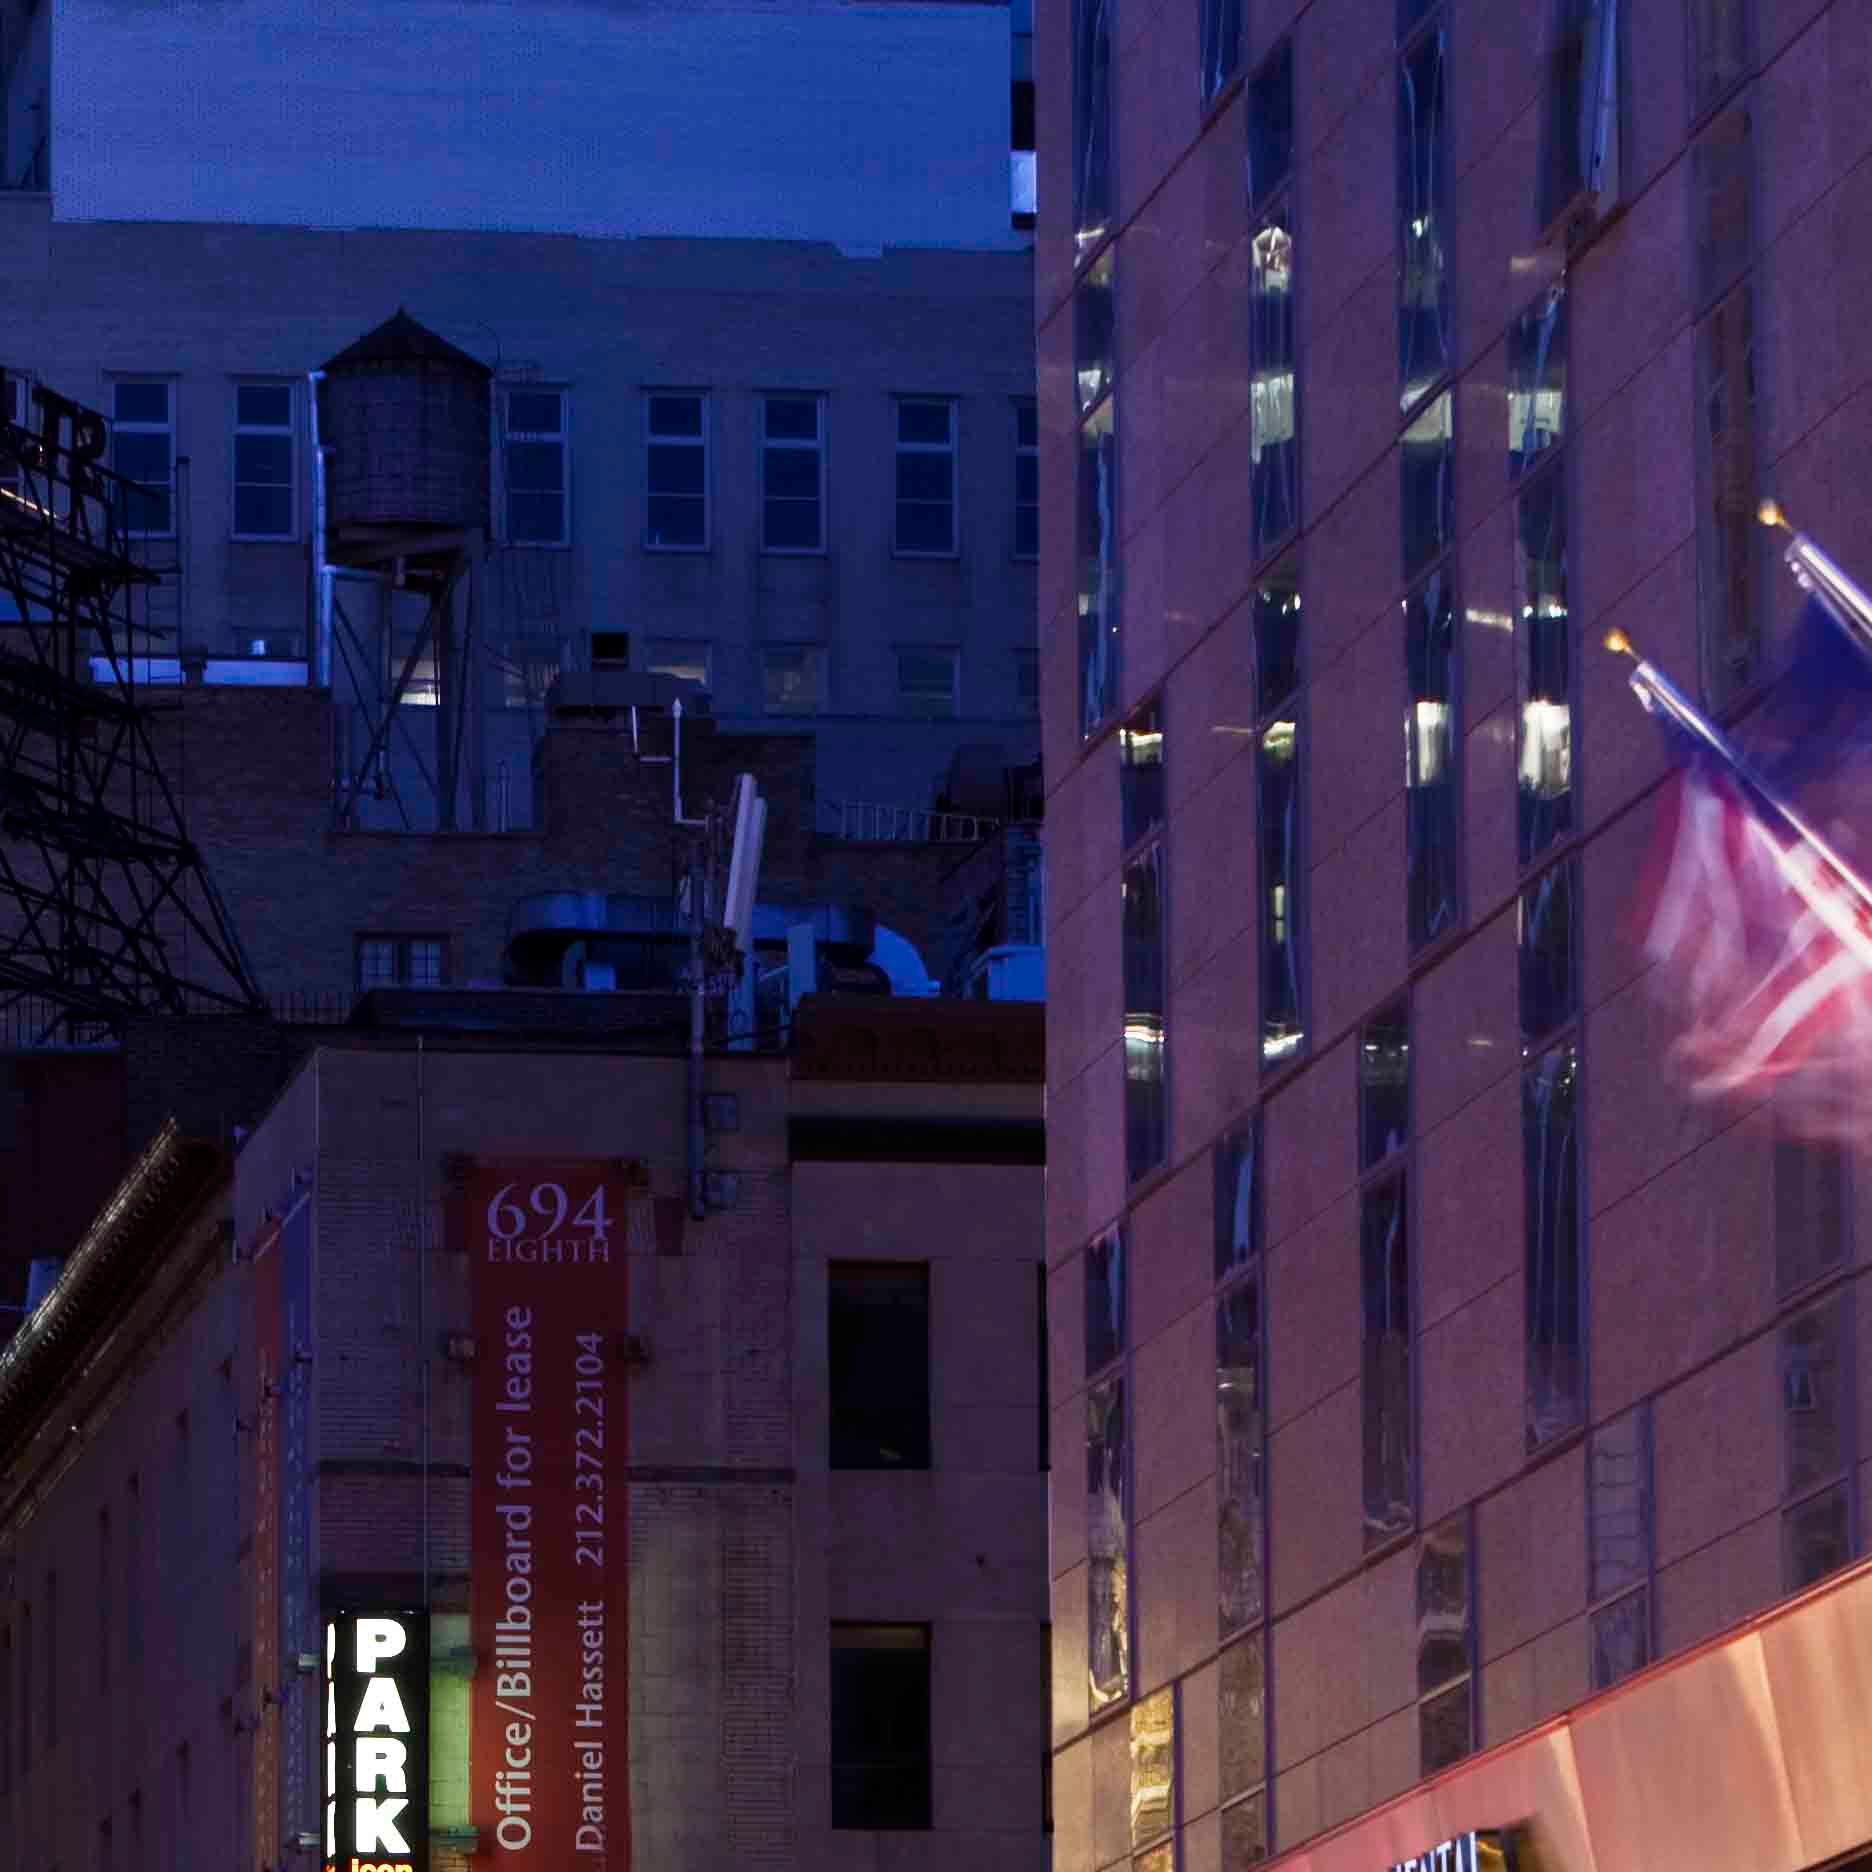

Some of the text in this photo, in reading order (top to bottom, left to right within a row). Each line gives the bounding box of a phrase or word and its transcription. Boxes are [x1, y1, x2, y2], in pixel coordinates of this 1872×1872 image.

[486, 1182, 614, 1243] 694
[487, 1239, 611, 1264] EIGHTH
[495, 1304, 532, 1852] Office/Billboard for lease
[575, 1330, 606, 1853] Daniel Hassett 212.372.2104
[353, 1618, 411, 1854] PARK
